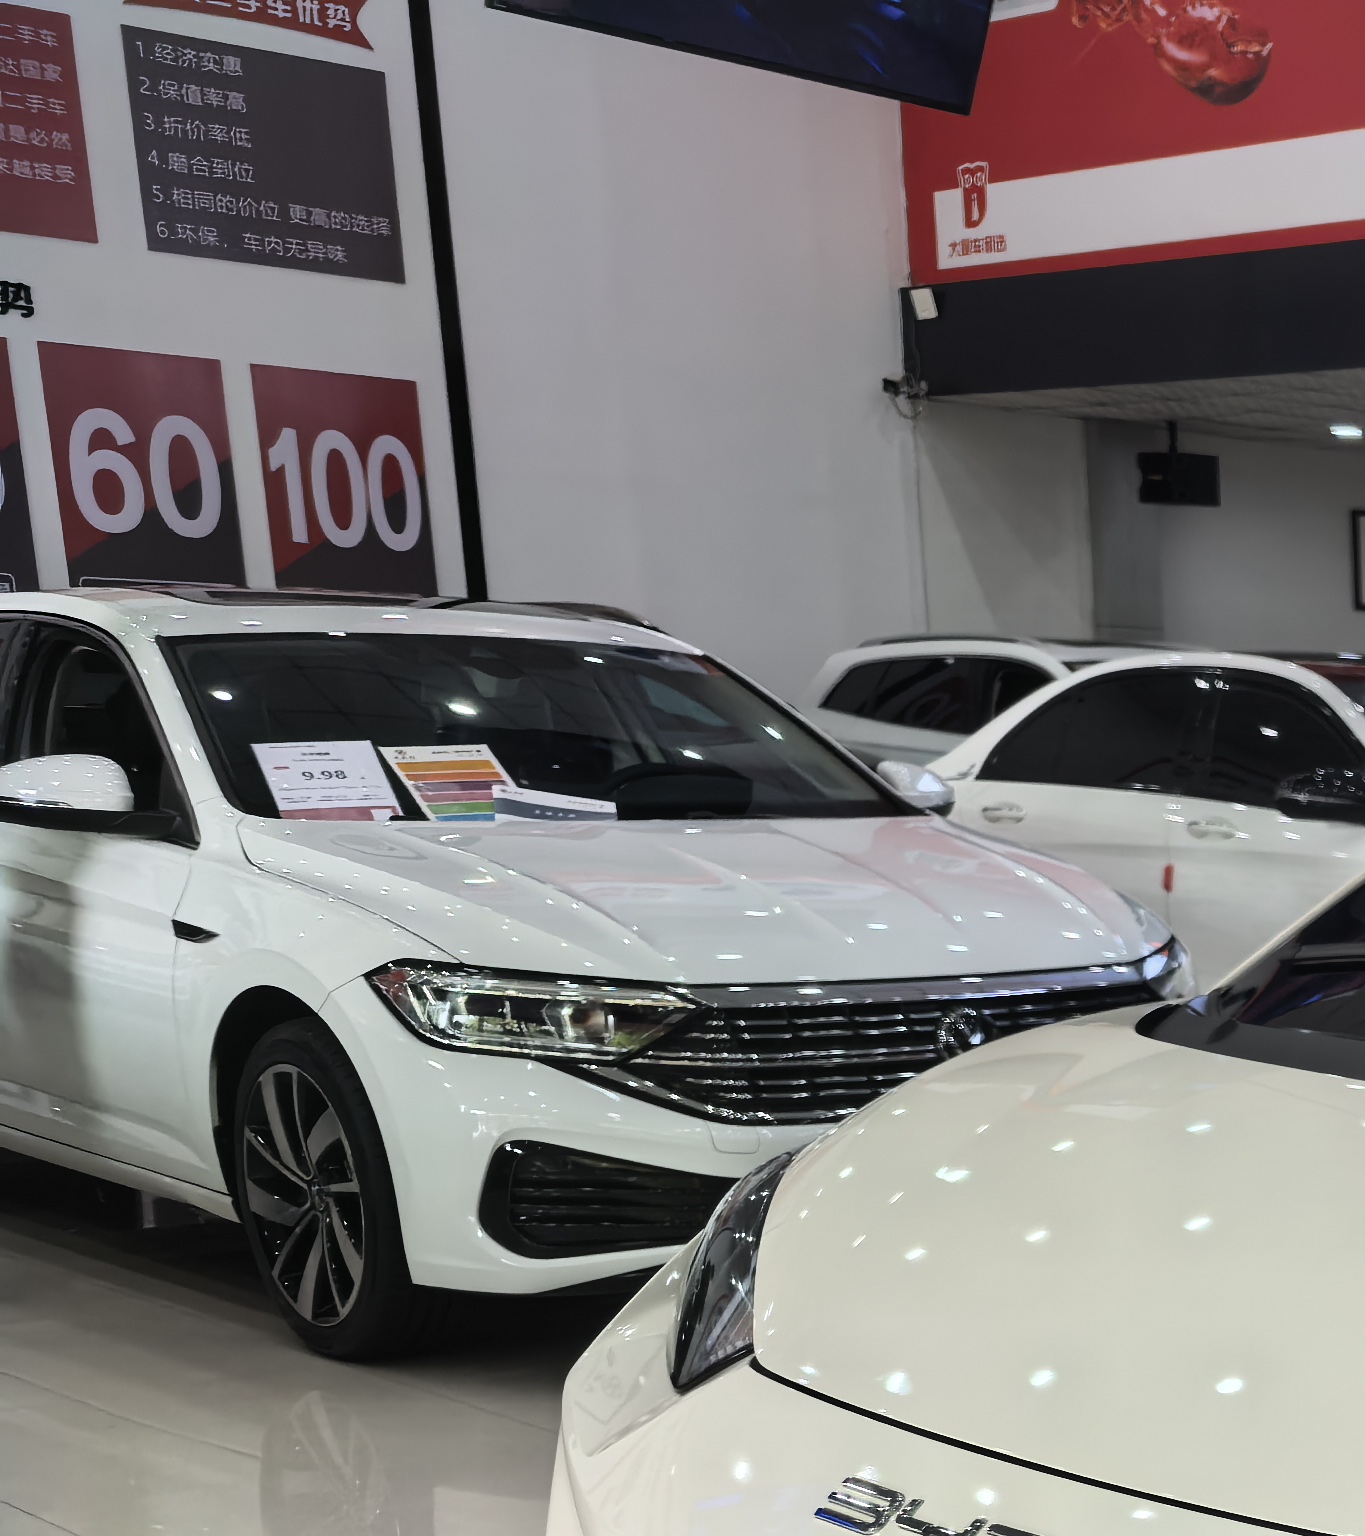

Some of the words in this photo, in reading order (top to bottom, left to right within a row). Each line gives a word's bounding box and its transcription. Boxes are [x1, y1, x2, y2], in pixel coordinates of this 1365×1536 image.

[206, 0, 352, 31] 车优势
[136, 41, 243, 76] 1.经济实惠
[0, 91, 67, 115] 二手车
[139, 77, 246, 113] 2.保值率高
[143, 112, 252, 148] 3.折价率低
[148, 150, 255, 182] 4.磨合到位
[68, 406, 223, 539] 60
[268, 426, 422, 553] 100
